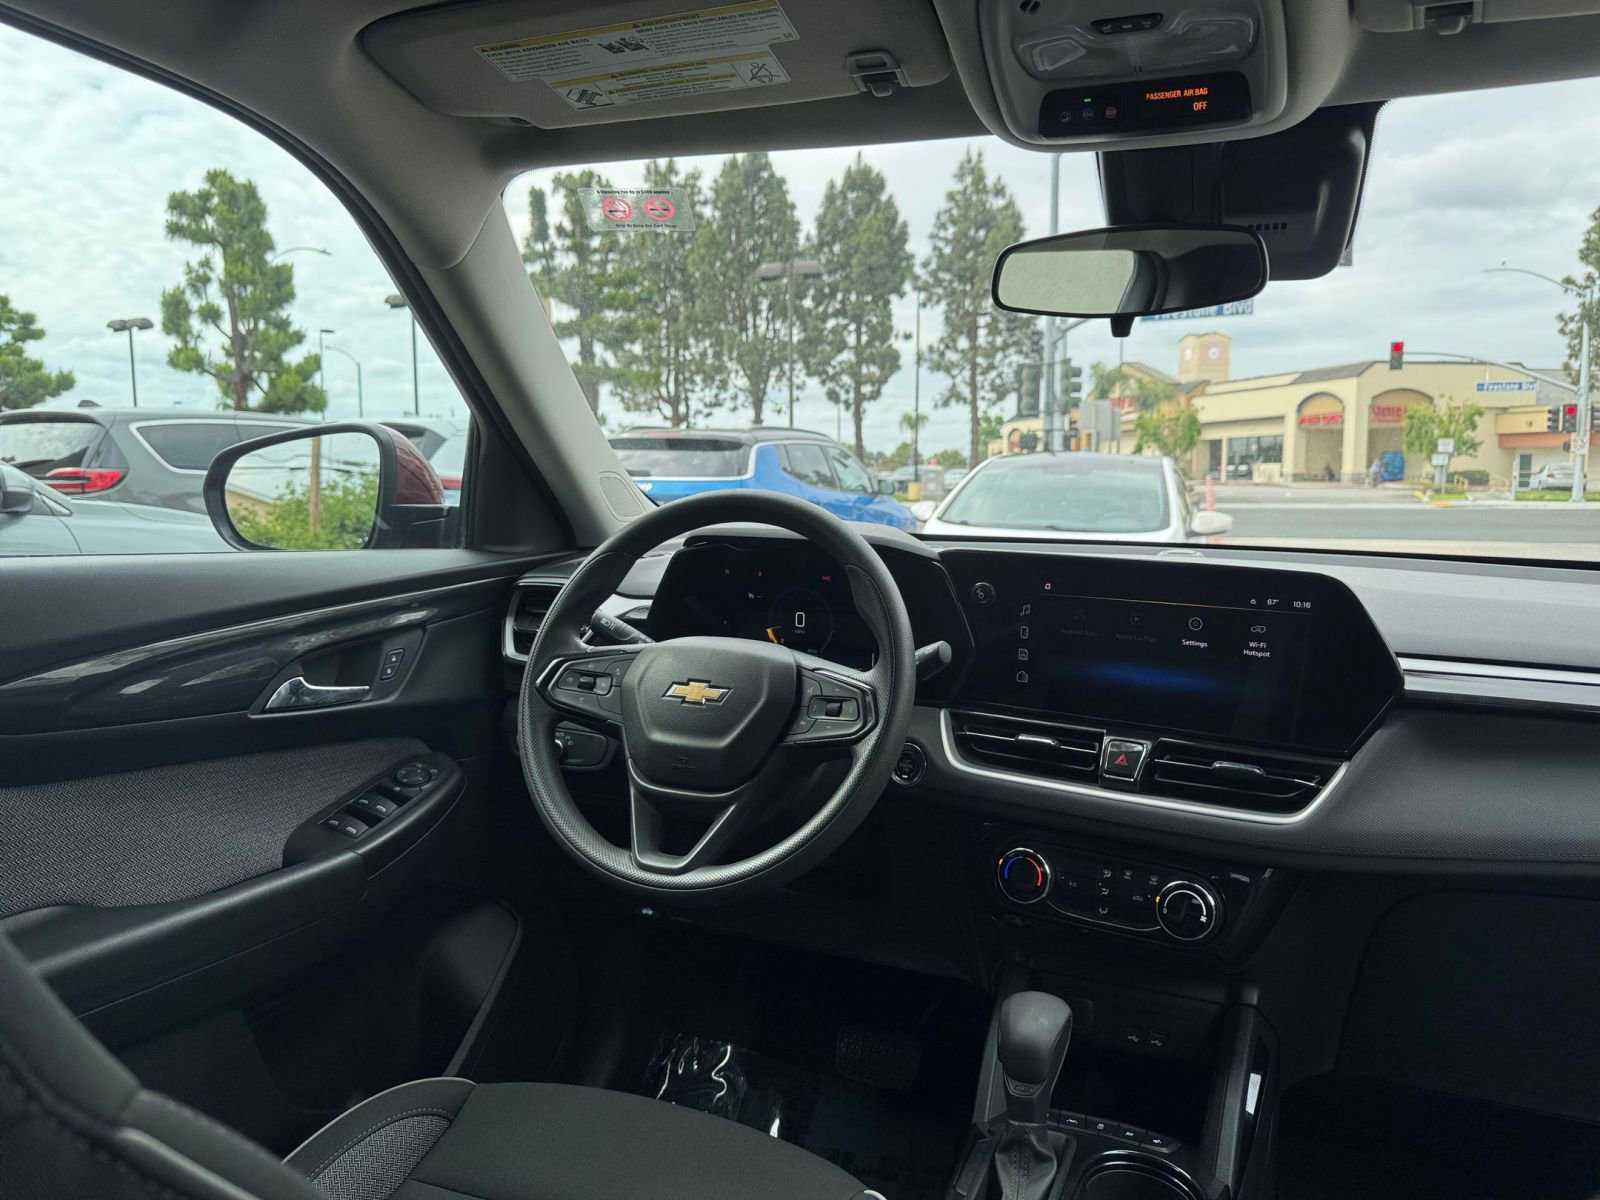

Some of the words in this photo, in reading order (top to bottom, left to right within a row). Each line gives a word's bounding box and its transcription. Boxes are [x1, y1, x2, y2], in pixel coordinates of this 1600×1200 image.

[1145, 90, 1182, 101] PASSENGER
[1183, 89, 1194, 97] AIR
[1195, 87, 1208, 96] BAG
[1193, 101, 1208, 112] OFF
[1223, 299, 1252, 315] Blvd
[1293, 600, 1311, 609] 10:16
[795, 611, 805, 628] 0
[1181, 638, 1208, 649] Settings
[1249, 641, 1267, 649] Wi-Fi
[1243, 649, 1271, 658] Hotspot
